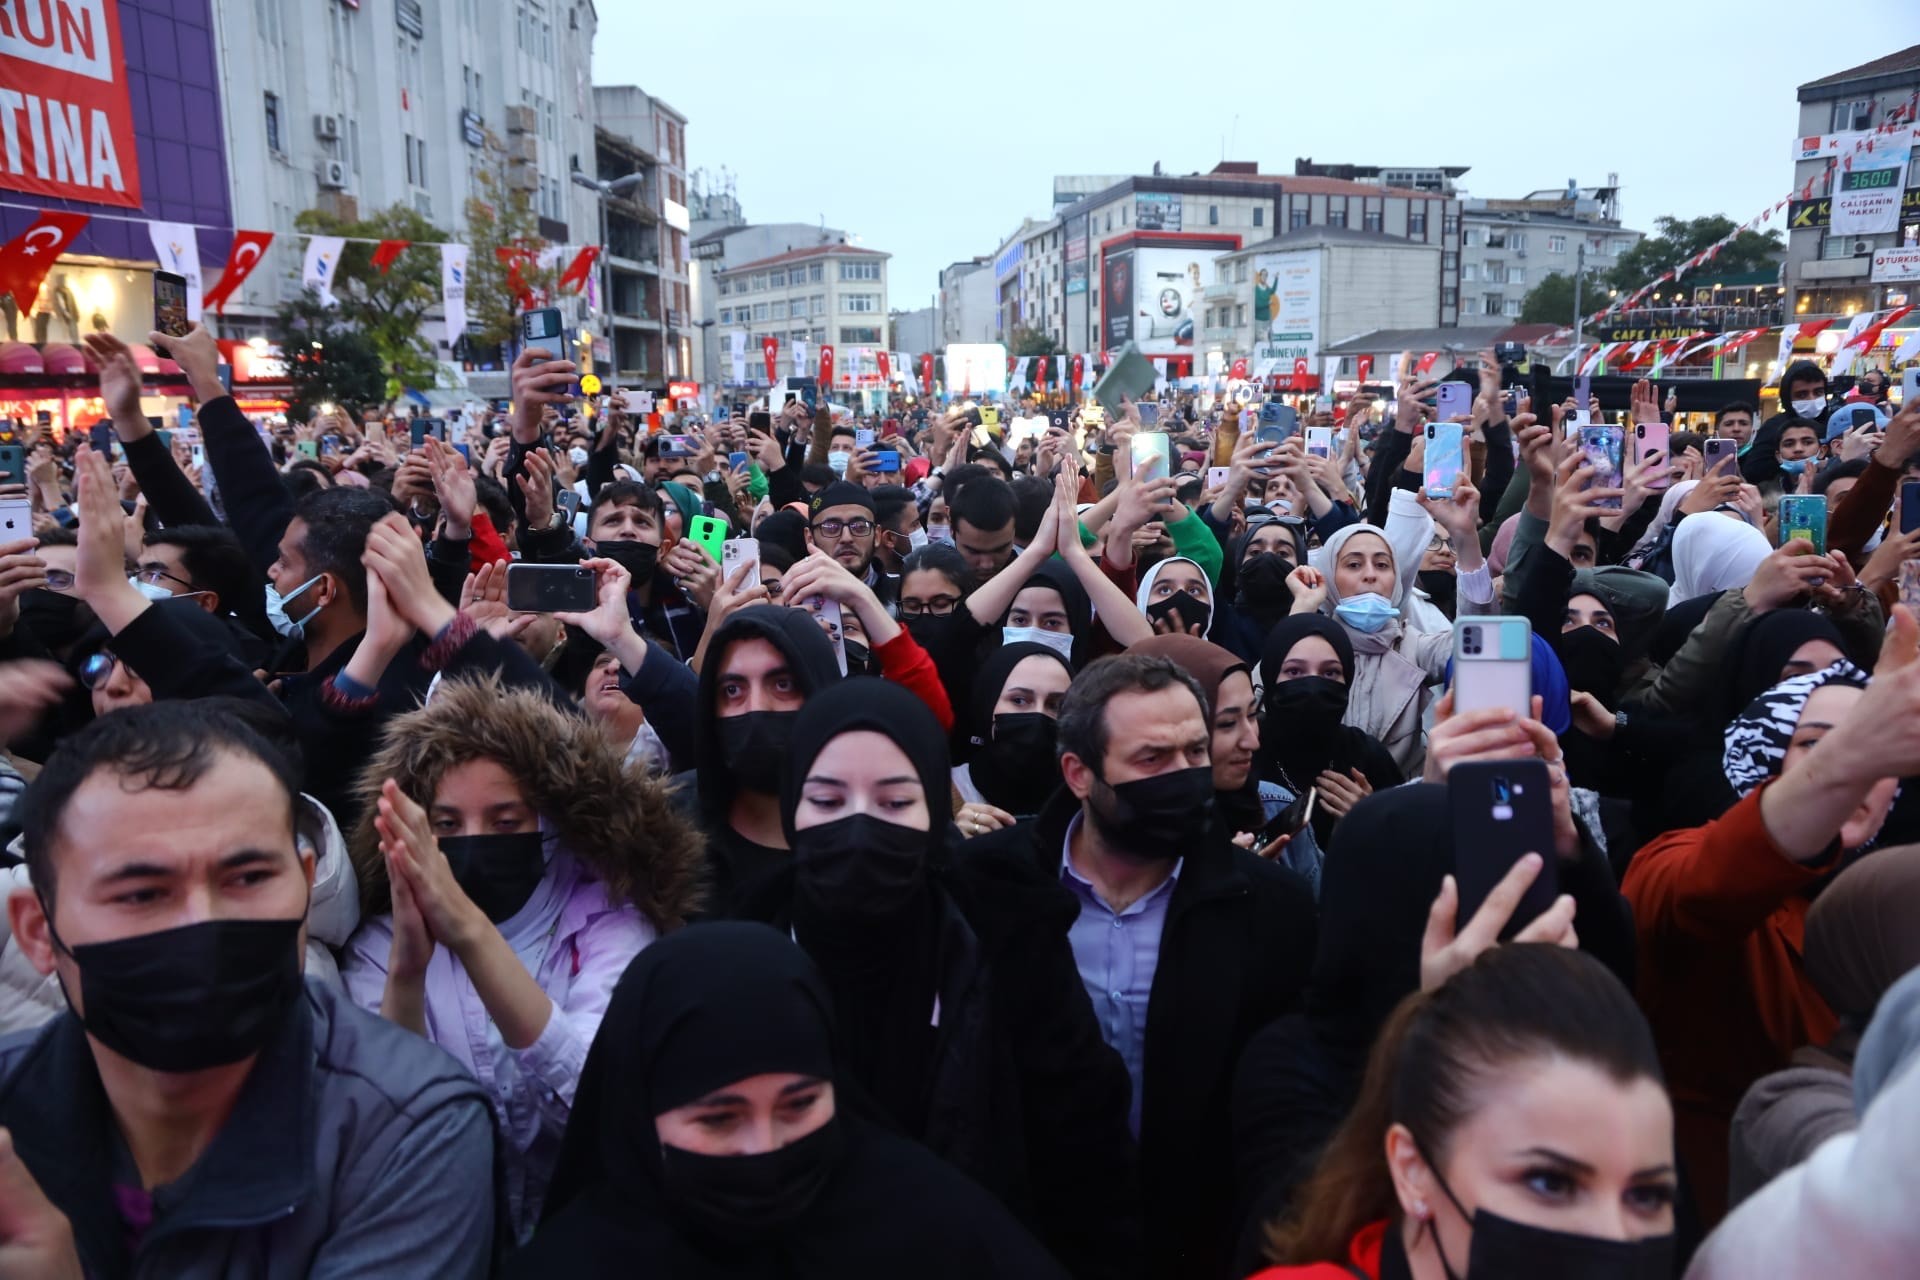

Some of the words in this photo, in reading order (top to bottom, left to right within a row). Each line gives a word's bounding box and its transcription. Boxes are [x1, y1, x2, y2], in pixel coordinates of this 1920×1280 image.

[1850, 171, 1892, 188] 3600
[1612, 329, 1645, 341] CAFE
[1261, 346, 1308, 359] EMİNEVİM
